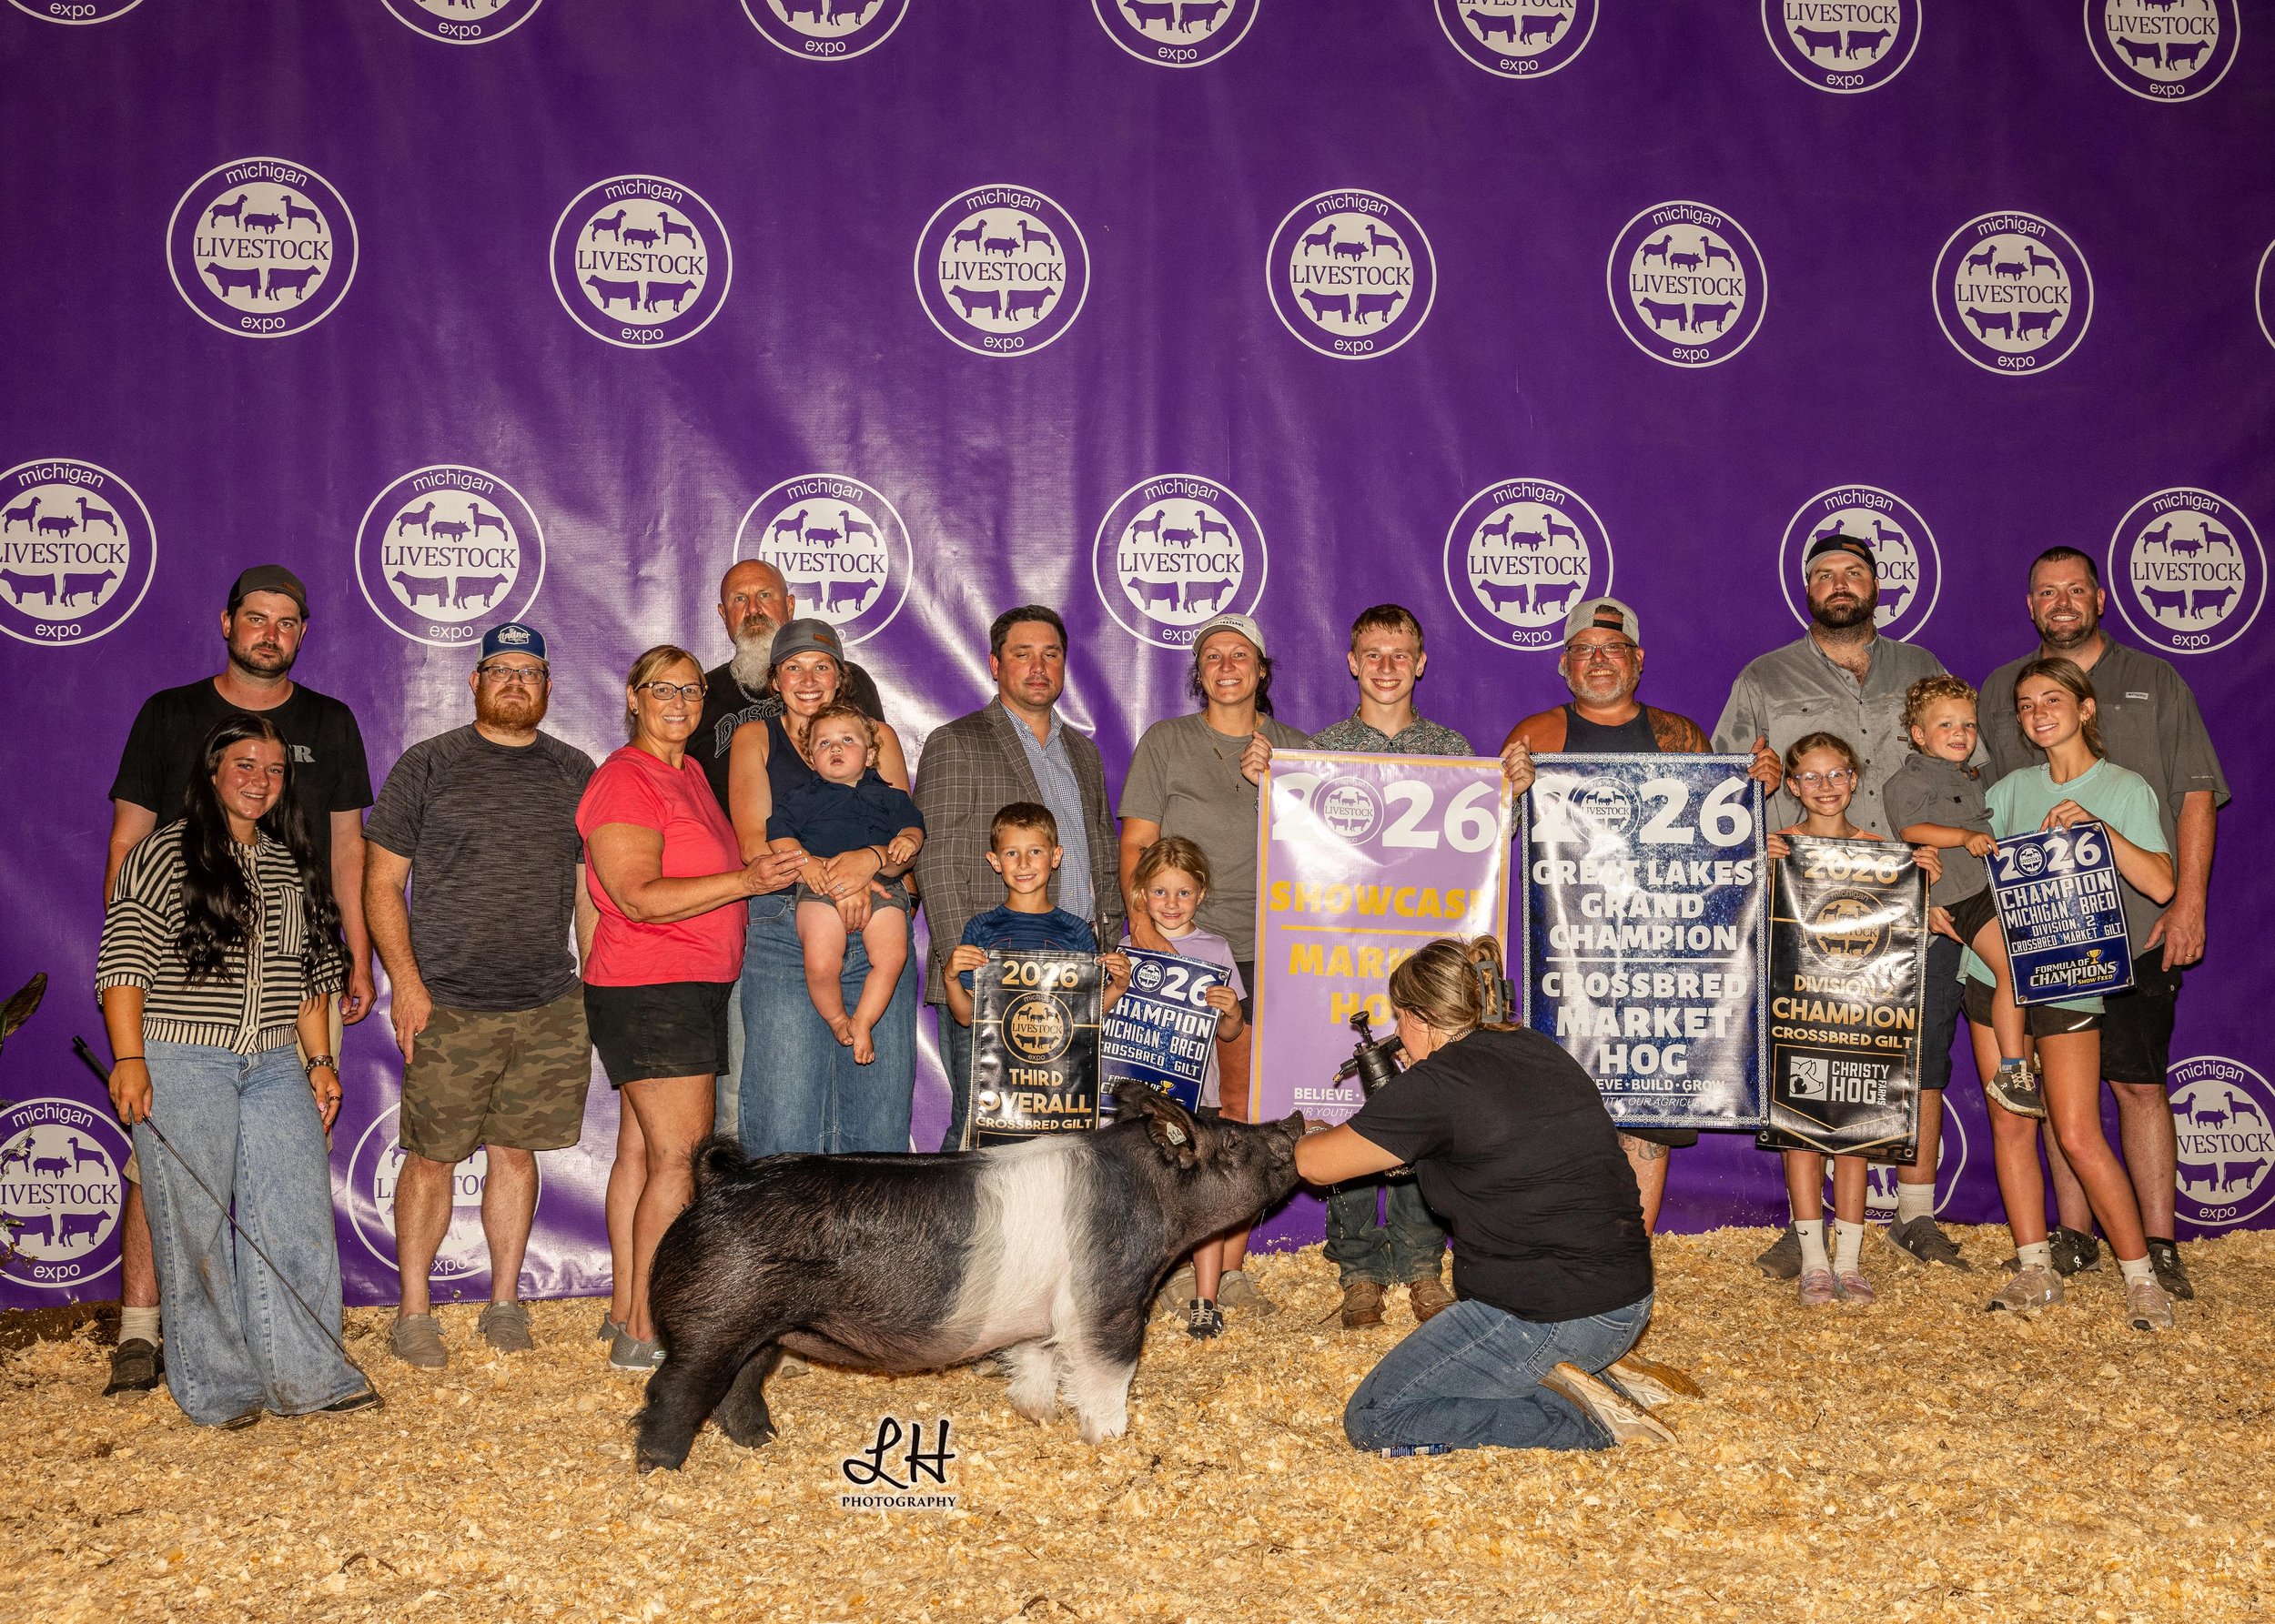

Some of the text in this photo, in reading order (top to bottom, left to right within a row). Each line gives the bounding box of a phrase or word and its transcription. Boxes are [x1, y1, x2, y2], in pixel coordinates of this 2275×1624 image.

[50, 3, 96, 19] expo
[1785, 3, 1897, 24] LIVESTOCK
[438, 20, 481, 38] expo
[2107, 14, 2218, 35] LIVESTOCK
[805, 37, 846, 55] expo
[1158, 44, 1197, 63] expo
[1500, 58, 1539, 74] expo
[1826, 74, 1864, 89] expo
[2149, 80, 2185, 97] expo
[226, 162, 308, 187] michigan
[604, 179, 683, 203] michigan
[966, 189, 1042, 210] michigan
[1315, 193, 1390, 216] michigan
[1652, 205, 1722, 228] michigan
[1977, 215, 2047, 237] michigan
[197, 236, 329, 261] LIVESTOCK
[578, 250, 705, 275] LIVESTOCK
[941, 260, 1063, 283] LIVESTOCK
[1291, 264, 1411, 287] LIVESTOCK
[1632, 274, 1744, 297] LIVESTOCK
[1956, 284, 2068, 304] LIVESTOCK
[241, 312, 286, 331] expo
[622, 326, 664, 343] expo
[984, 333, 1025, 351] expo
[1334, 336, 1374, 353] expo
[1672, 344, 1710, 362] expo
[1997, 351, 2037, 370] expo
[18, 464, 104, 488] michigan
[412, 470, 494, 495] michigan
[787, 479, 864, 501] michigan
[1145, 474, 1219, 501] michigan
[1493, 483, 1565, 505] michigan
[1825, 489, 1894, 511] michigan
[2152, 492, 2219, 513] michigan
[0, 543, 126, 564] IVESTOCK
[384, 545, 516, 569] LIVESTOCK
[1119, 551, 1241, 574] LIVESTOCK
[1470, 556, 1588, 575] LIVESTOCK
[2133, 562, 2242, 581] LIVESTOCK
[35, 623, 81, 641] expo
[430, 622, 473, 641] expo
[1512, 630, 1552, 646] expo
[2172, 635, 2210, 649] expo
[288, 744, 316, 762] R
[1325, 806, 1373, 817] LIVESTOCK
[1533, 860, 1754, 886] GREAT LAKES
[1805, 850, 1898, 884] 2026
[1831, 889, 1869, 903] michigan
[1999, 870, 2113, 910] CHAMPION
[1581, 893, 1704, 918] GRAND
[2005, 891, 2117, 929] MICHIGAN BRED
[2032, 915, 2096, 937] DIVISION 2
[1550, 925, 1737, 951] CHAMPION
[2012, 923, 2121, 953] CROSSBRED MARKET GILT
[1289, 943, 1414, 979] MARK
[2035, 958, 2089, 974] FORMULA OF
[1002, 960, 1078, 988] 2026
[2029, 961, 2118, 988] CHAMPIONS
[1542, 972, 1747, 999] CROSSBRED
[1795, 973, 1876, 998] DIVISION
[1109, 997, 1212, 1038] HAMPION
[1330, 992, 1392, 1026] HO
[1773, 997, 1916, 1030] CHAMPION
[1012, 1023, 1063, 1034] LIVESTOCK
[1556, 1007, 1733, 1038] MARKET
[1102, 1018, 1206, 1062] MICHIGAN BRED
[1772, 1026, 1913, 1049] CROSSBRED GILT
[1027, 1054, 1046, 1062] expo
[1101, 1041, 1199, 1077] ROSSBRED GILT
[1599, 1044, 1688, 1075] HOG
[1009, 1068, 1064, 1087] THIRD
[1832, 1061, 1890, 1079] CHRISTY
[2176, 1061, 2244, 1084] michigan
[1294, 1087, 1353, 1101] BELIEVE
[1632, 1078, 1673, 1090] BUILD
[1683, 1079, 1725, 1091] GROW
[1831, 1076, 1877, 1105] HOG
[1876, 1079, 1887, 1105] FARMS
[979, 1091, 1092, 1114] OVERALL
[1317, 1106, 1353, 1117] YOUTH
[1628, 1097, 1653, 1106] OUR
[11, 1103, 94, 1129] michigan
[976, 1117, 1092, 1130] CROSSBRED GILT
[1168, 1128, 1183, 1140] 314
[2177, 1134, 2273, 1154] VESTOCK
[0, 1184, 118, 1205] IVESTOCK
[1865, 1208, 1896, 1218] exp
[2199, 1206, 2237, 1221] expo
[34, 1262, 80, 1281] expo
[430, 1258, 467, 1275] xpo
